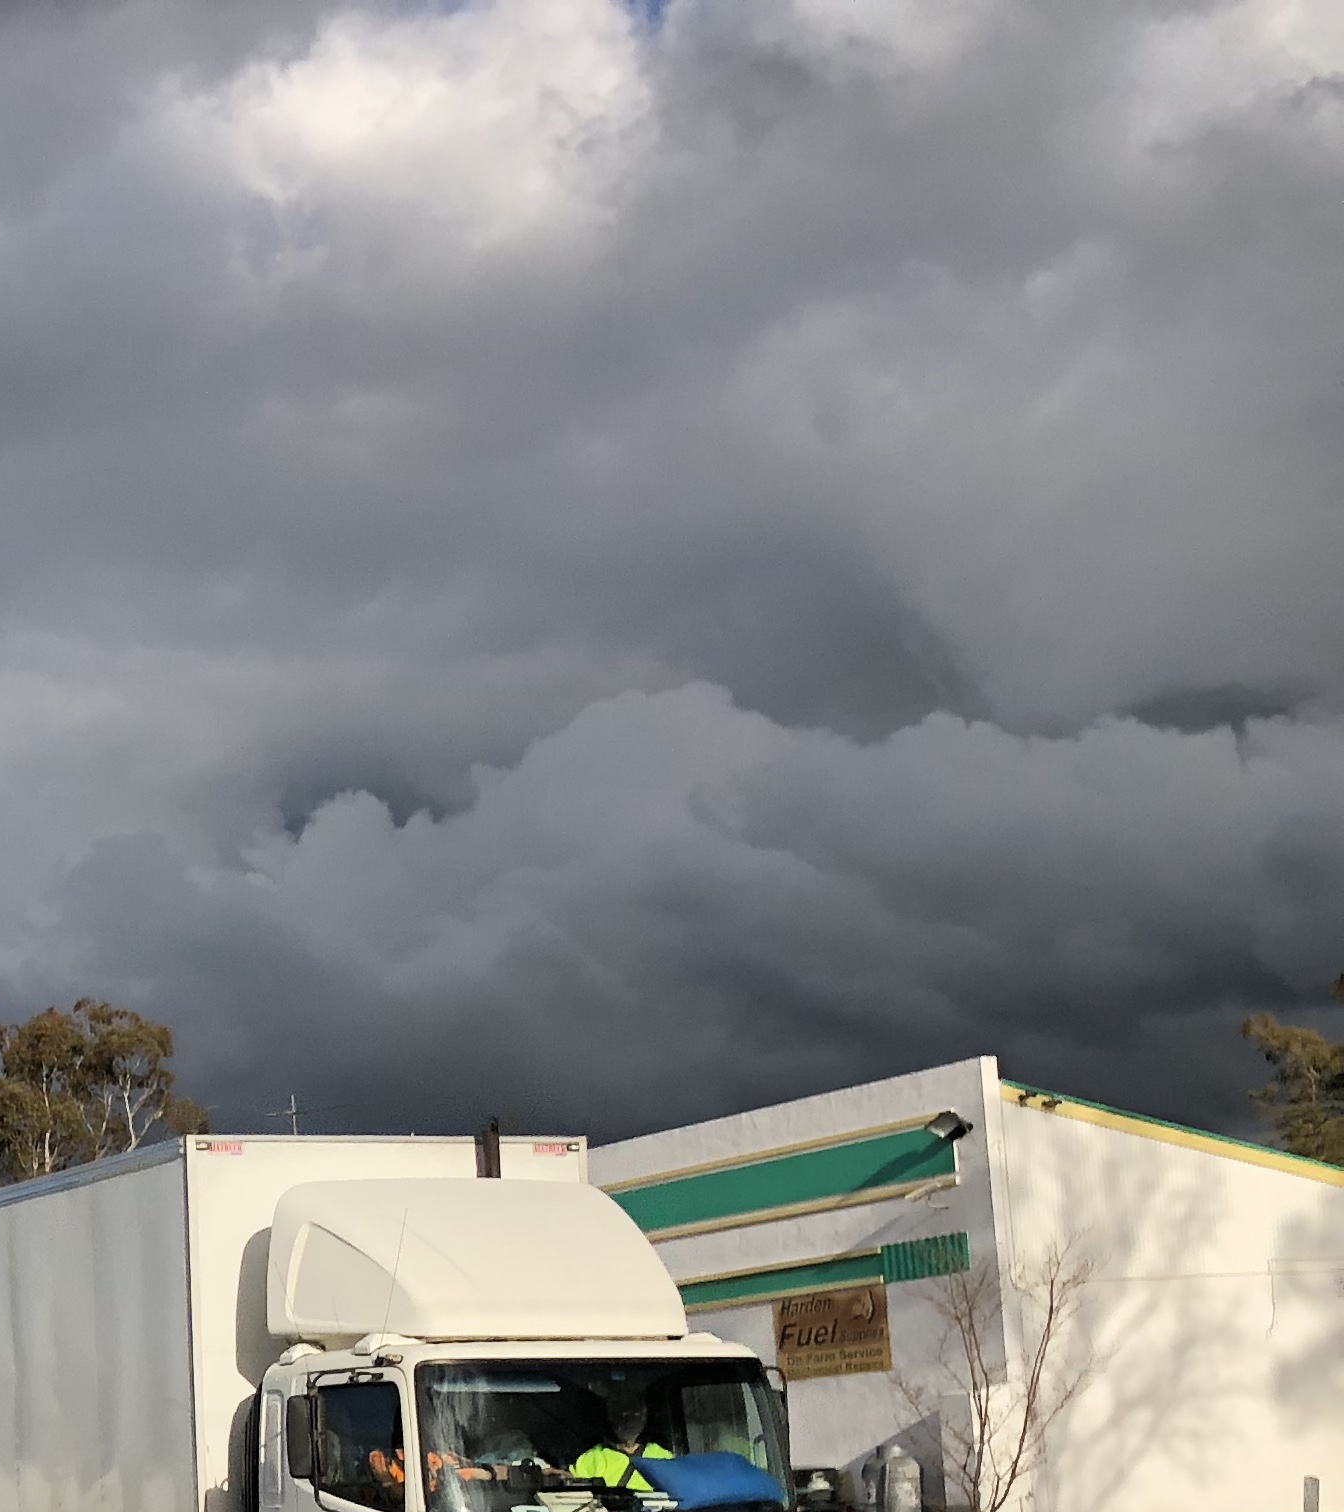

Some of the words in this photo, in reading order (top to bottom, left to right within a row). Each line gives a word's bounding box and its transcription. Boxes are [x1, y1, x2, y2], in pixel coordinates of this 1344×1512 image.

[781, 1297, 831, 1316] Harden
[779, 1318, 838, 1351] Fuel
[839, 1346, 883, 1360] Service
